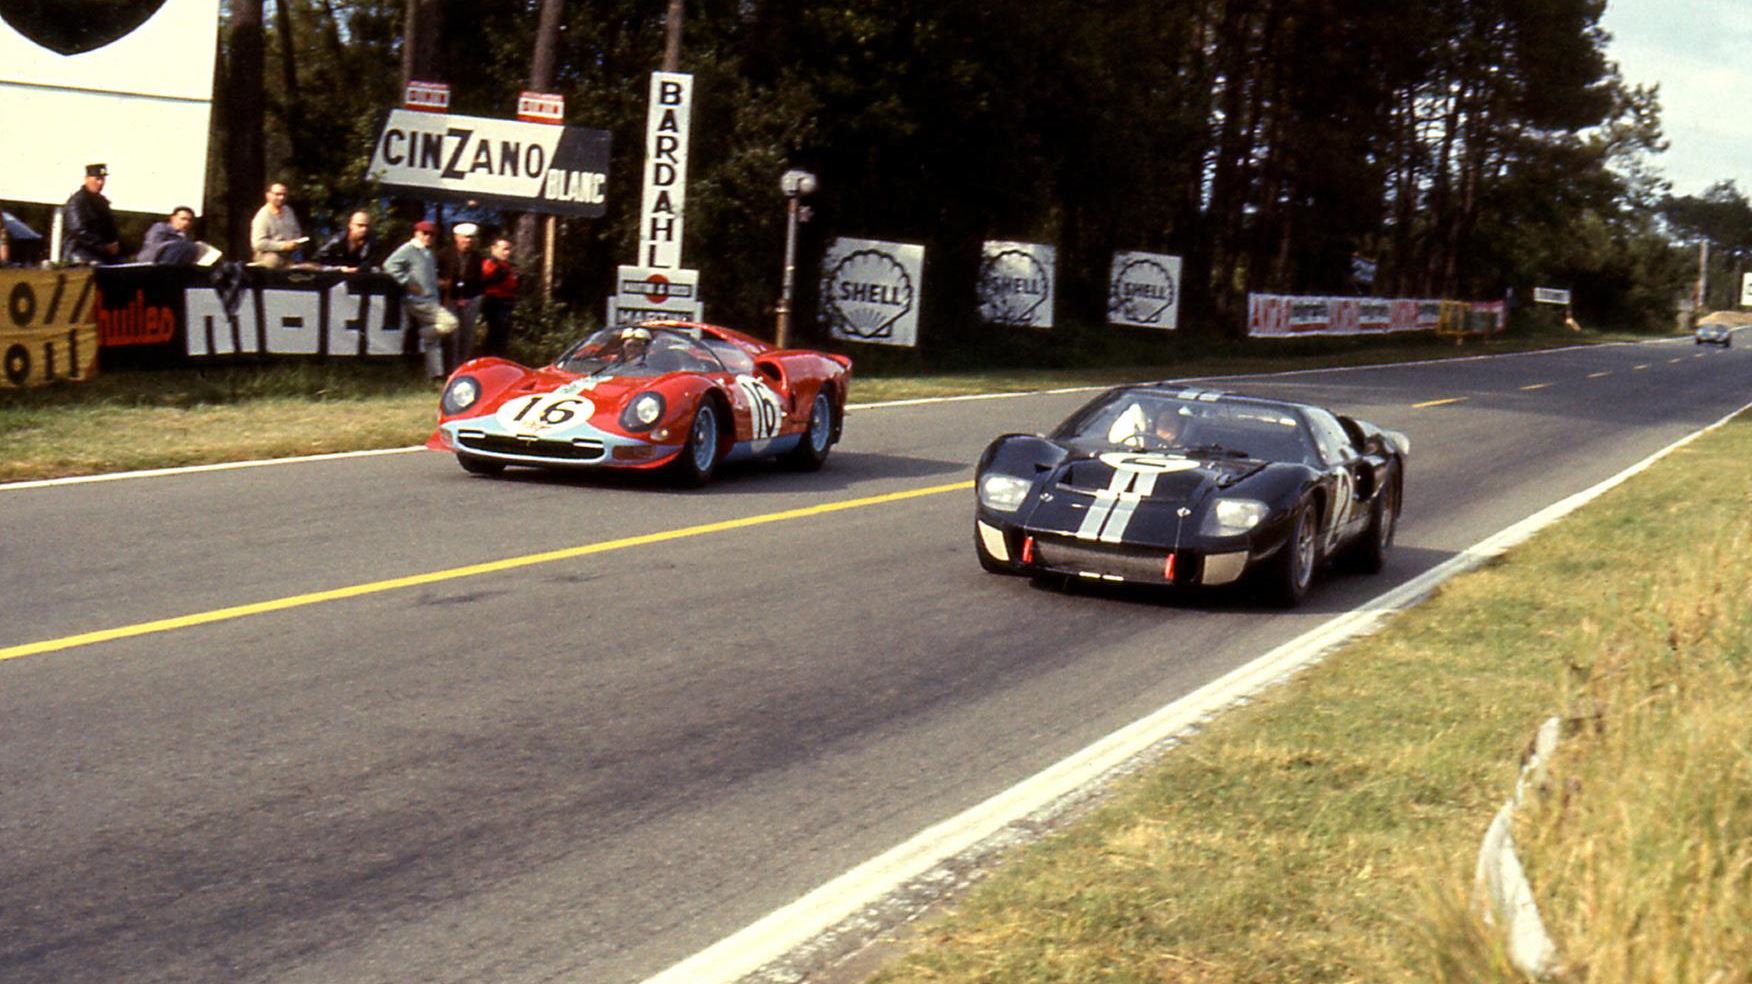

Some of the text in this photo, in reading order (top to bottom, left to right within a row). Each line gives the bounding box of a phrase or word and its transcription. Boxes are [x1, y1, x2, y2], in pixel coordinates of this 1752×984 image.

[382, 128, 545, 180] CINZANO
[545, 168, 607, 204] BLANC
[647, 81, 682, 269] BARDAHL
[840, 281, 902, 306] SHELL
[1124, 282, 1167, 300] SHELL
[513, 396, 584, 425] 16
[741, 381, 776, 440] 16
